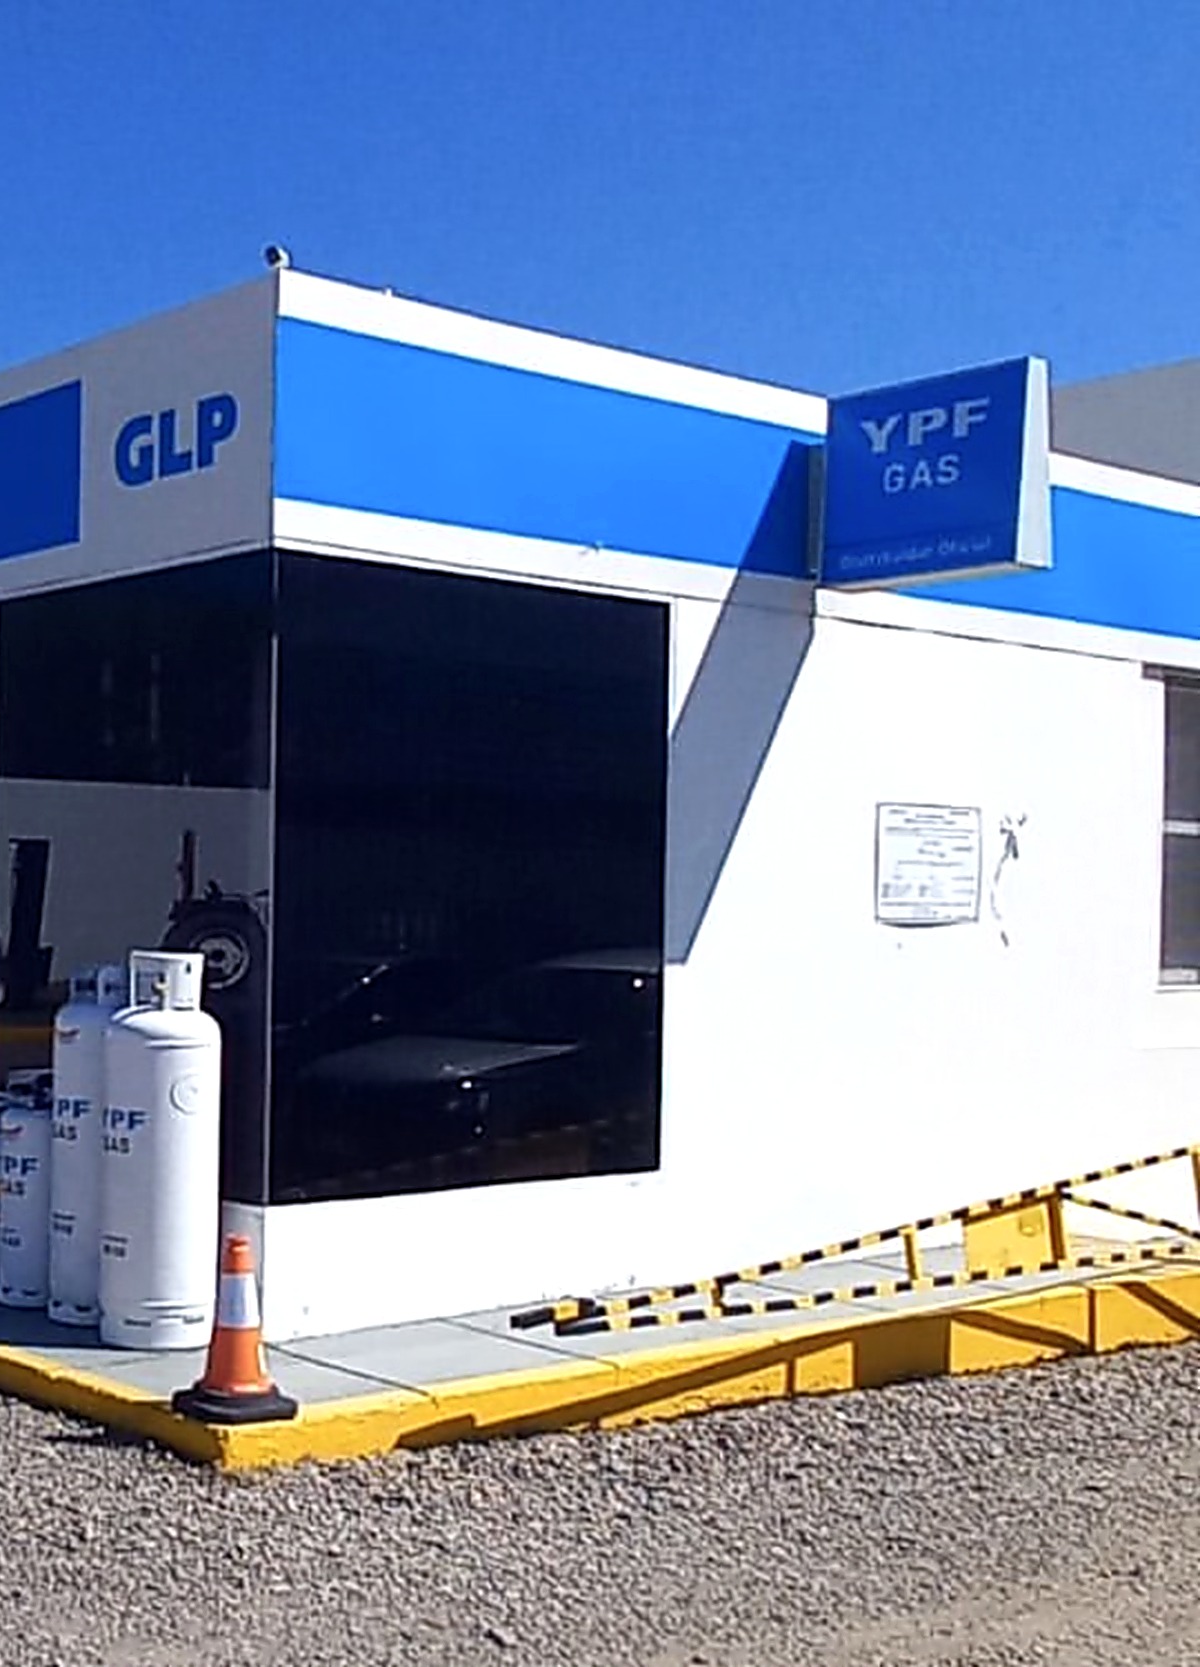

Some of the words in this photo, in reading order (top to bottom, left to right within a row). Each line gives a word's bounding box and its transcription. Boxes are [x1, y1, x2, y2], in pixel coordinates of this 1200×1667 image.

[115, 393, 238, 487] GLP
[860, 397, 991, 454] YPF
[883, 454, 960, 493] GAS
